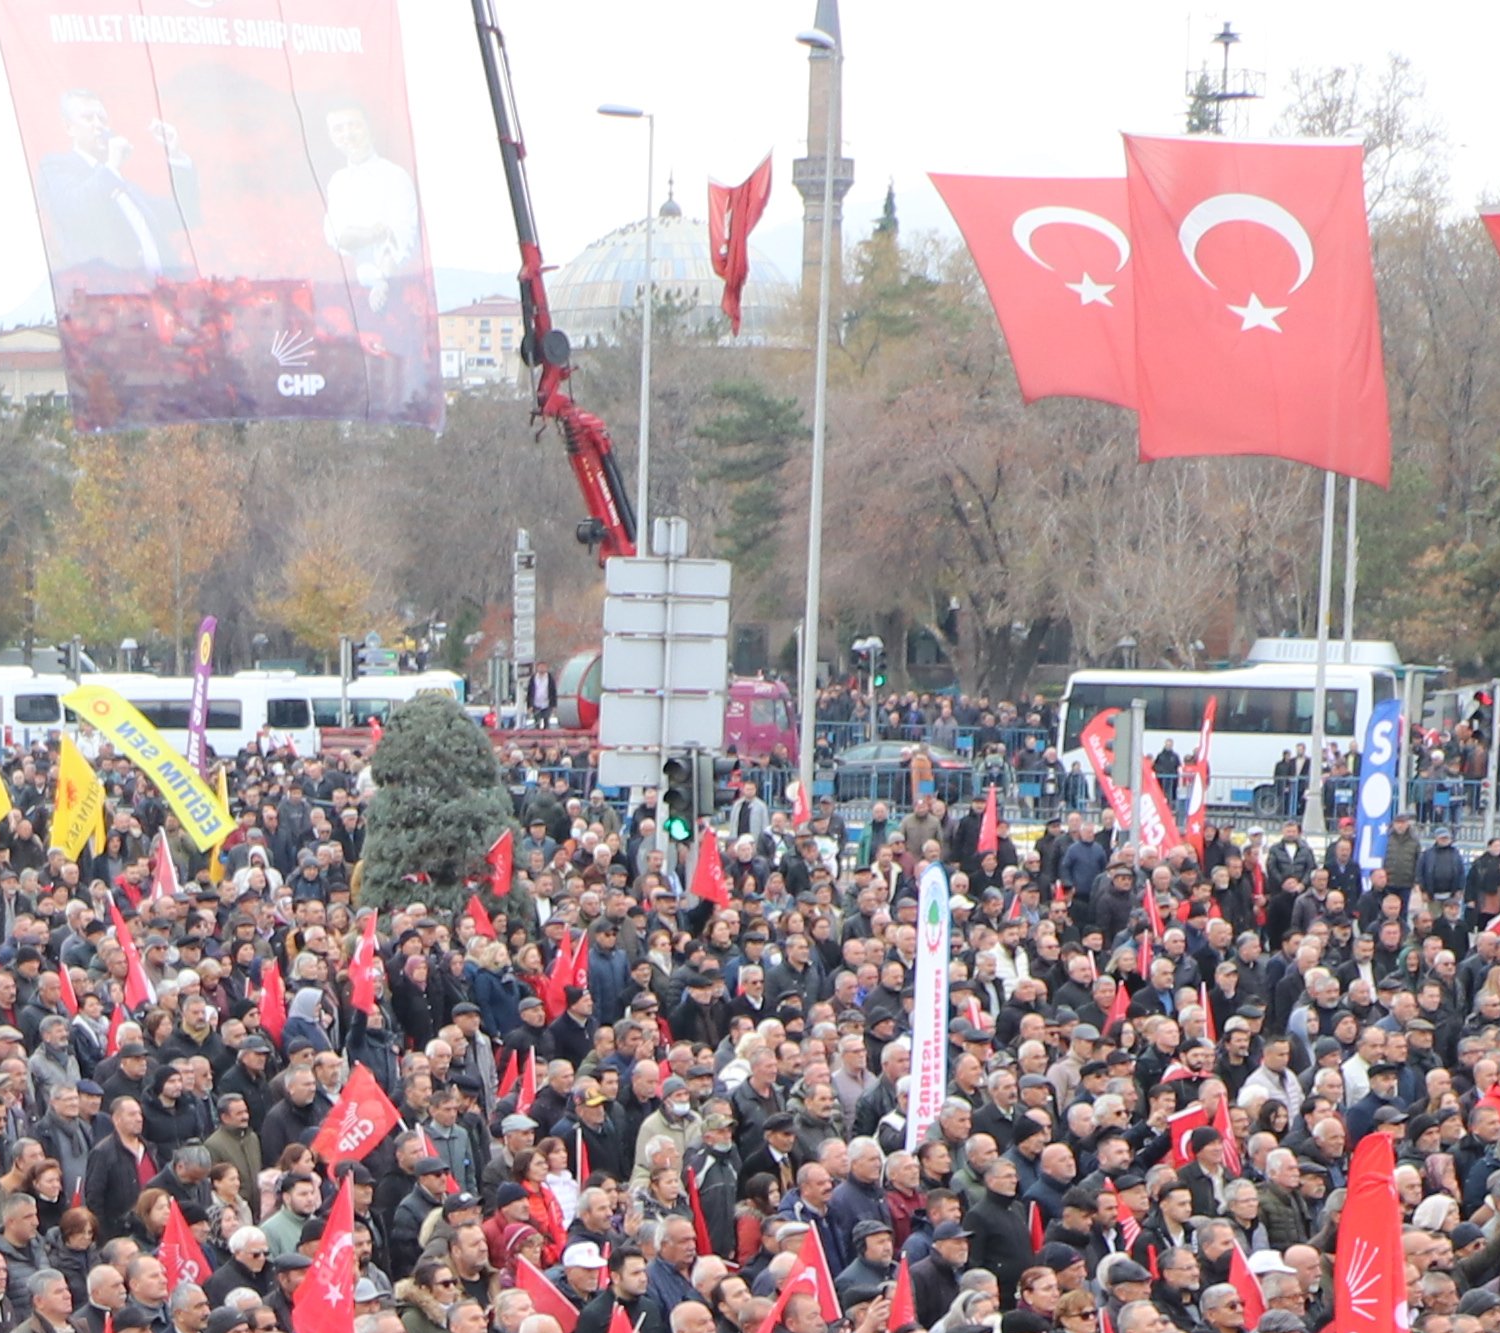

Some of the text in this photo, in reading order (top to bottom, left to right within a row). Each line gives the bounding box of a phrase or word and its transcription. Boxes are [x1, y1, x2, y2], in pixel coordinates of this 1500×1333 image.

[50, 14, 364, 55] MİLLET İRADESİNE SAHİP ÇIKIYOR
[278, 374, 325, 397] CHP
